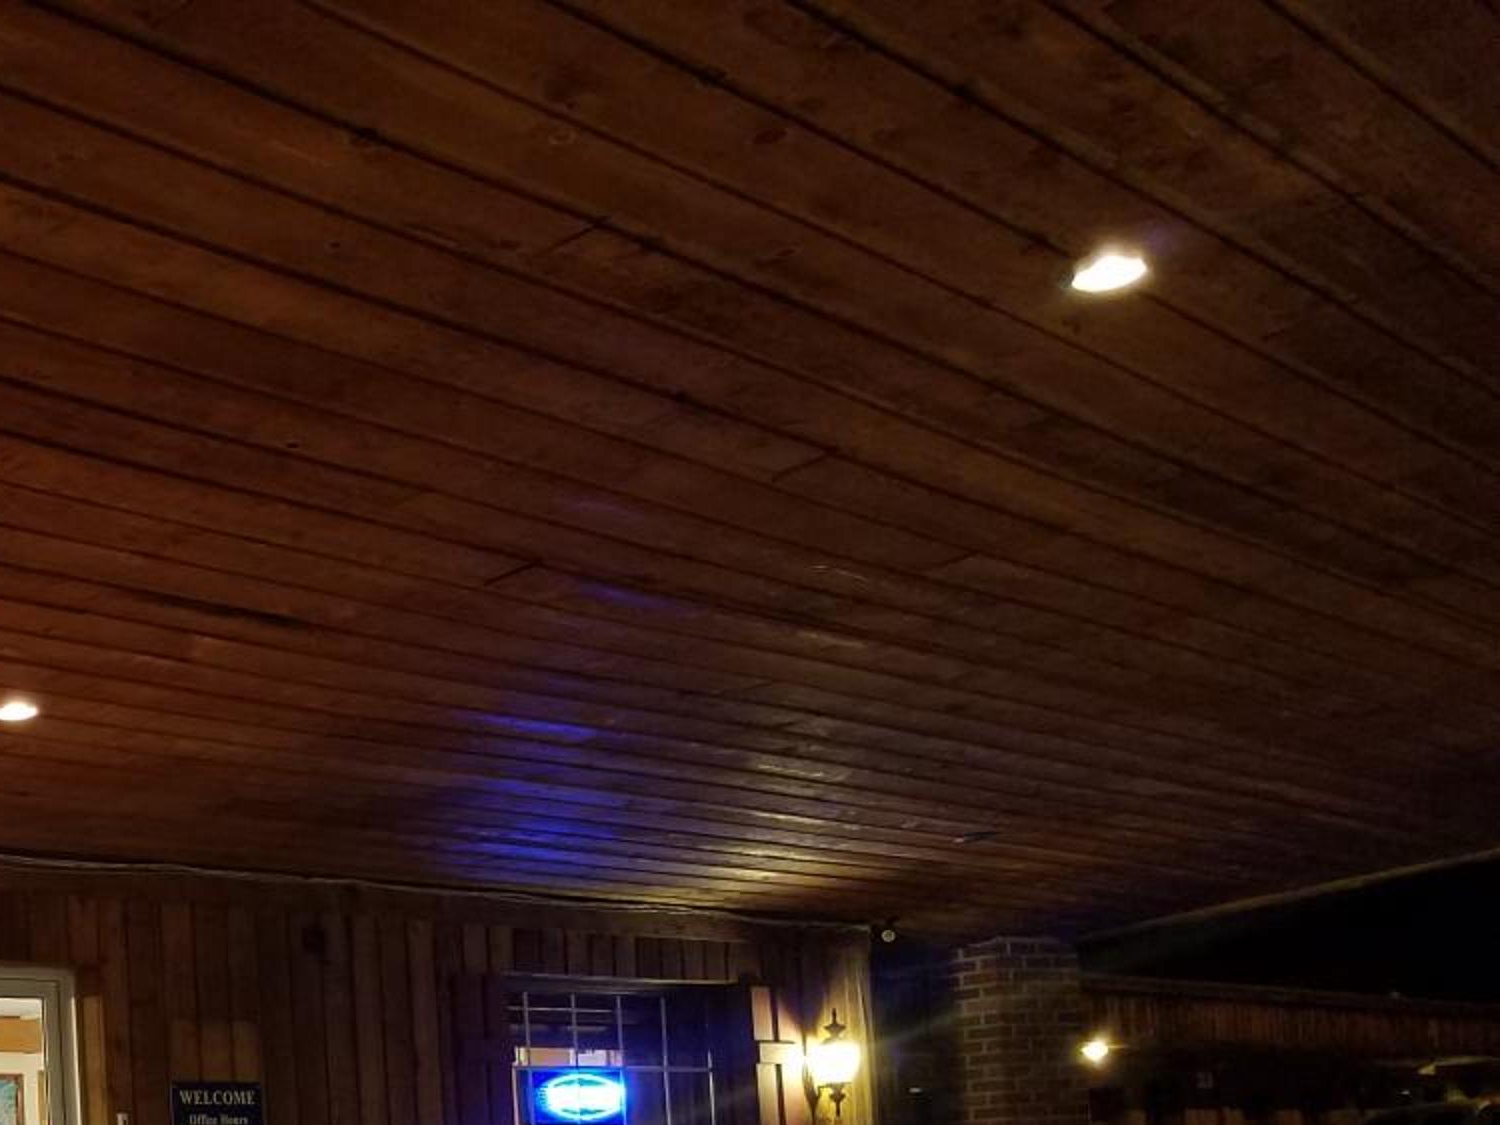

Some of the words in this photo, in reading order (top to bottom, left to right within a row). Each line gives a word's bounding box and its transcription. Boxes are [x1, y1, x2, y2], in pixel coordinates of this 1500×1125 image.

[179, 1089, 257, 1105] WELCOME
[188, 1113, 218, 1125] Office
[220, 1113, 249, 1125] Hours
